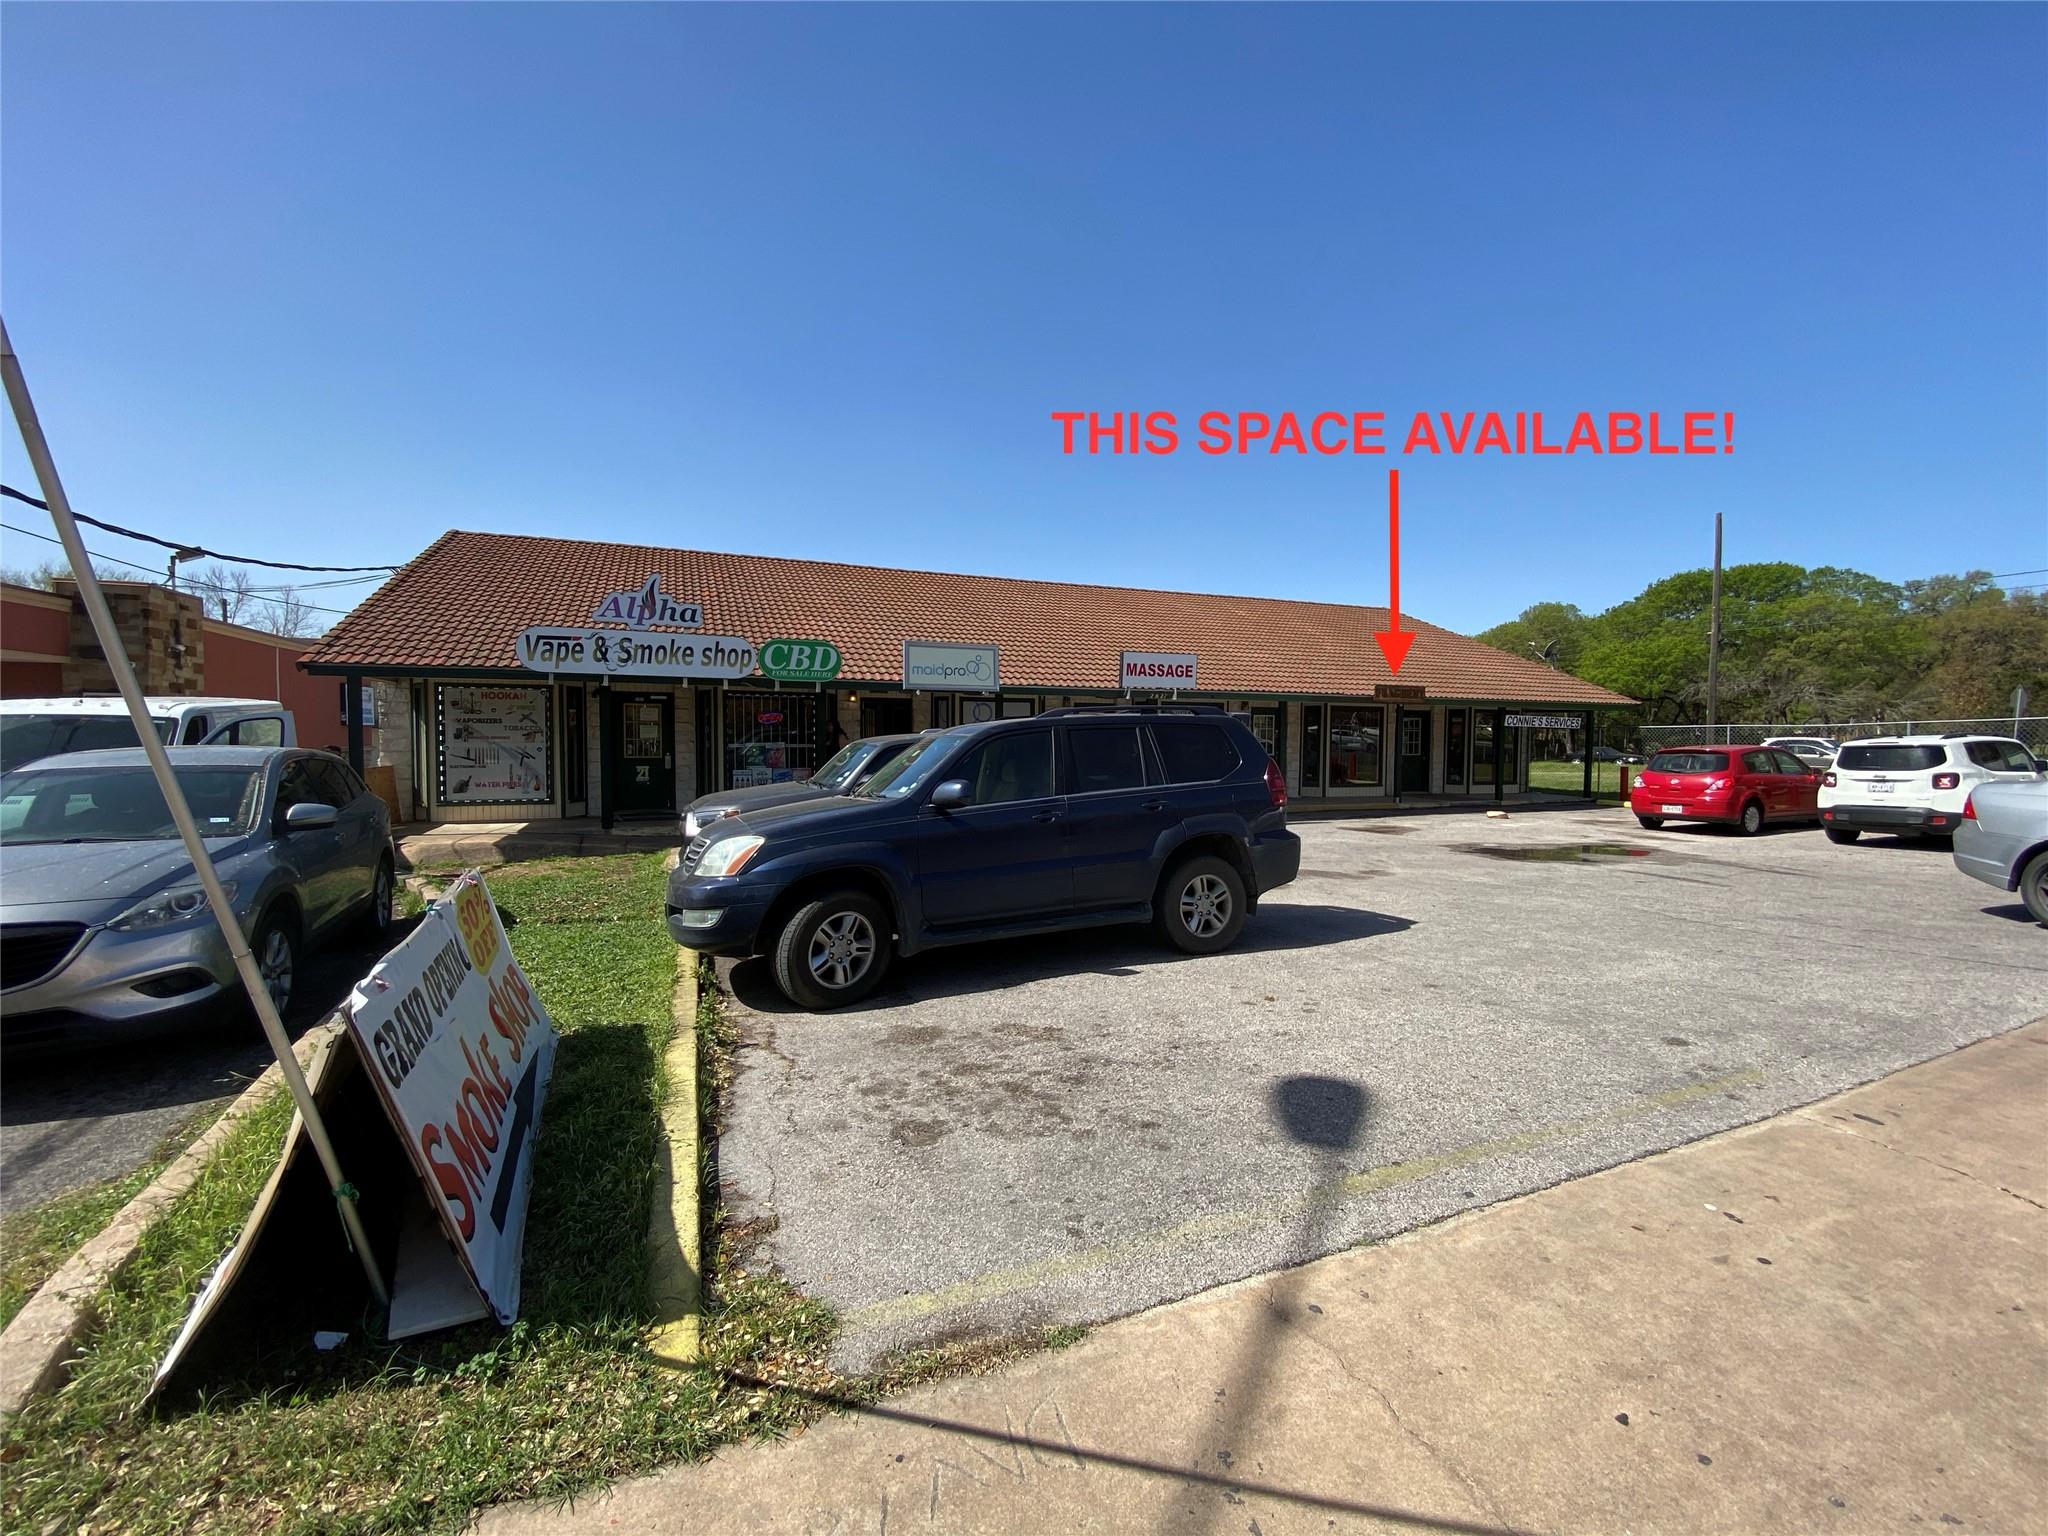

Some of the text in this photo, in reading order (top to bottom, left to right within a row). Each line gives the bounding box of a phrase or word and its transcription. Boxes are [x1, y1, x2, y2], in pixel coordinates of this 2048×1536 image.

[599, 583, 699, 627] Alpha
[525, 634, 753, 675] Vape & Smoke shop
[764, 643, 838, 671] CBD
[911, 663, 967, 680] maidpro
[1126, 662, 1194, 678] MASSAGE
[771, 669, 833, 678] FOR SALE HERE
[480, 691, 528, 700] HOOKAH
[1506, 715, 1581, 729] CONNIE'S SERVICES
[460, 886, 491, 940] 50%
[473, 920, 497, 968] OFF
[373, 985, 434, 1090] GRAND
[420, 962, 540, 1244] SMOKE SHOP
